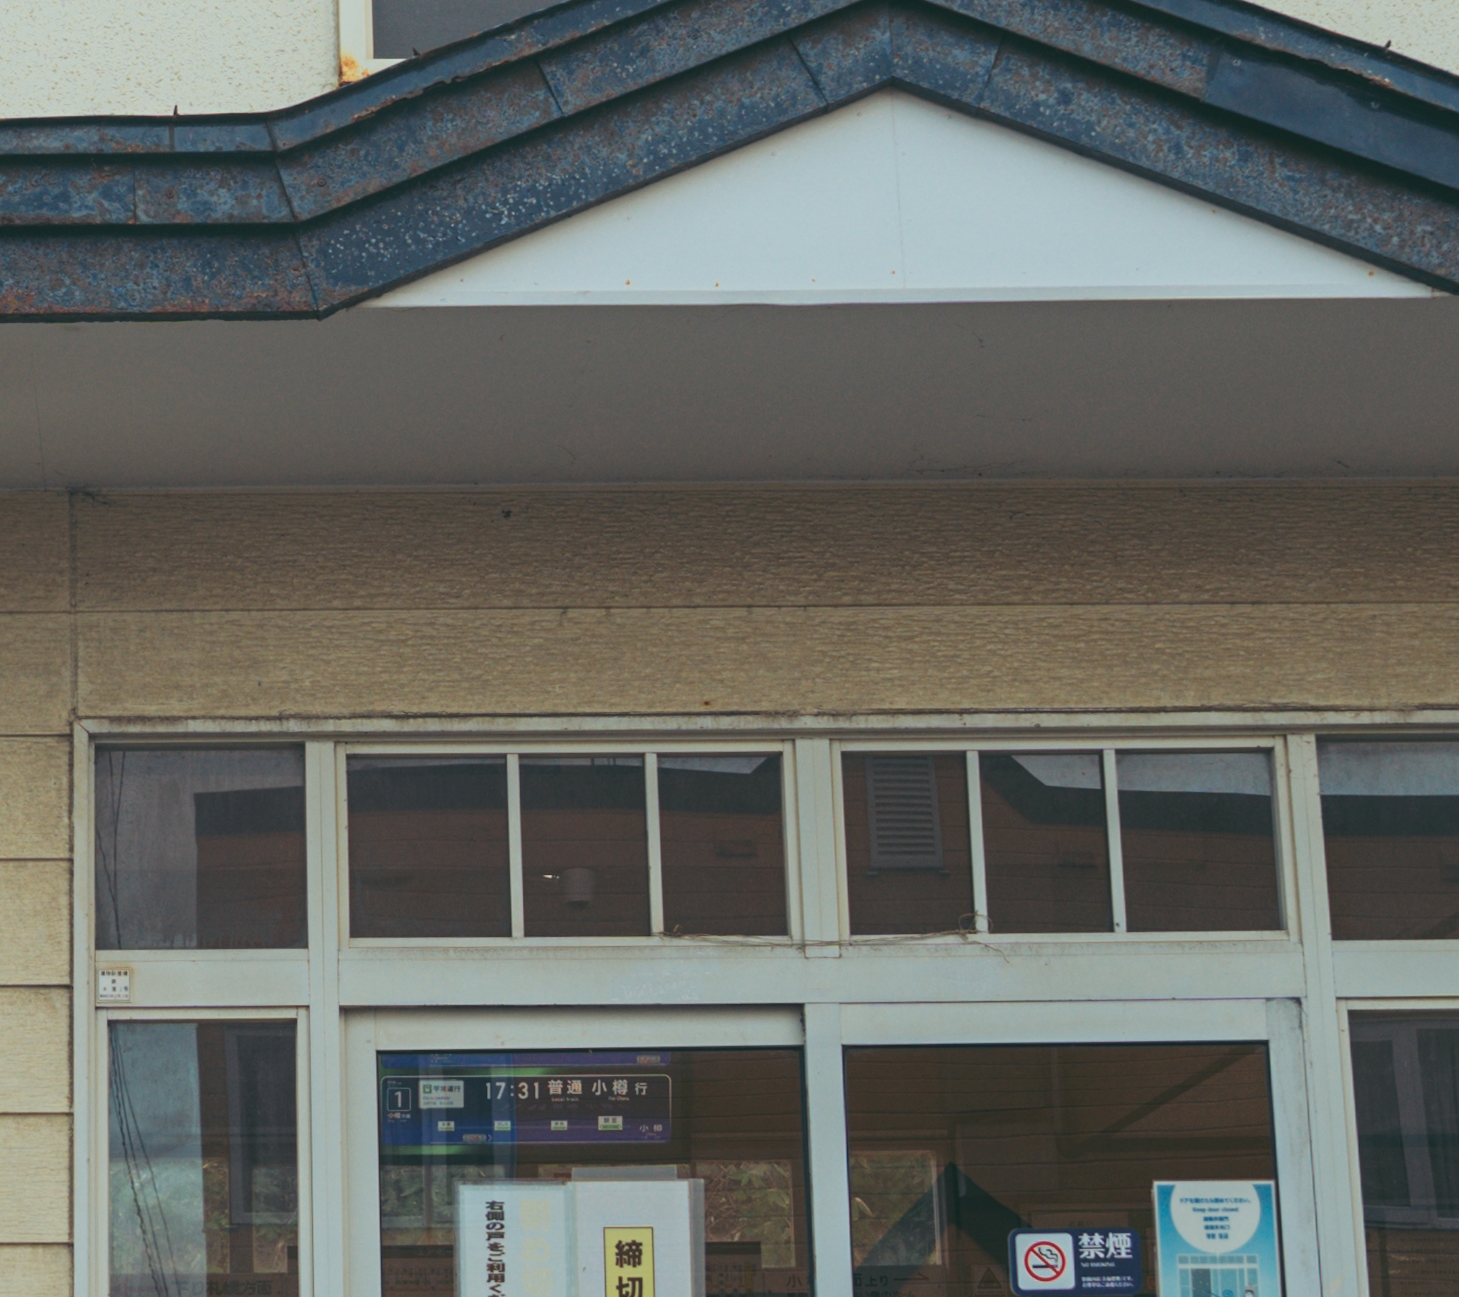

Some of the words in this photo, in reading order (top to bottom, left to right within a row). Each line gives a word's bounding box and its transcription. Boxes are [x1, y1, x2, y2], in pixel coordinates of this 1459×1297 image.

[394, 1090, 402, 1108] 1
[485, 1082, 540, 1100] 17:31
[547, 1079, 583, 1095] 普通
[591, 1079, 628, 1096] 小樽
[635, 1082, 648, 1095] 行
[1077, 1232, 1134, 1259] 禁煙
